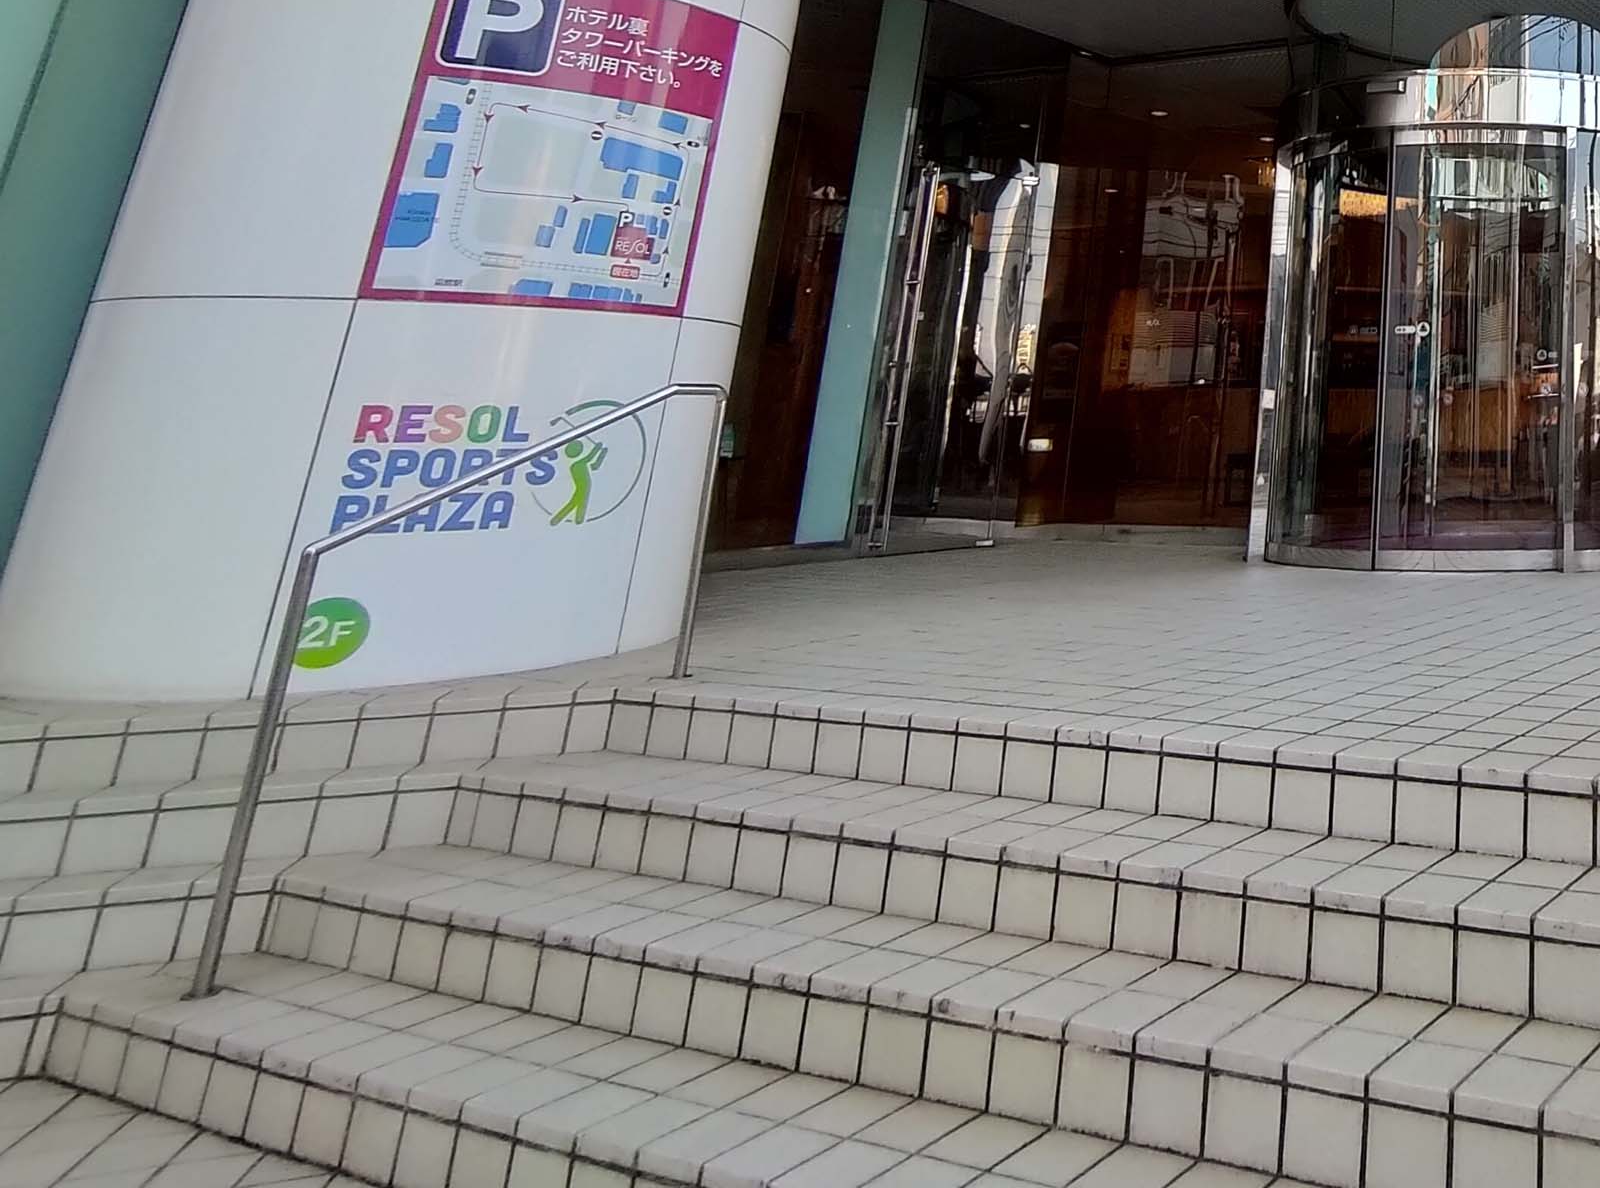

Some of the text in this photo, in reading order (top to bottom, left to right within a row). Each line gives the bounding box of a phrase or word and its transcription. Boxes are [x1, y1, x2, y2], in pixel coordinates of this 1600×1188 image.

[566, 6, 649, 37] ホテル裏
[614, 239, 651, 255] RESOL
[353, 404, 530, 443] RESOL
[341, 448, 559, 489] SPORTS
[297, 615, 356, 649] 2F
